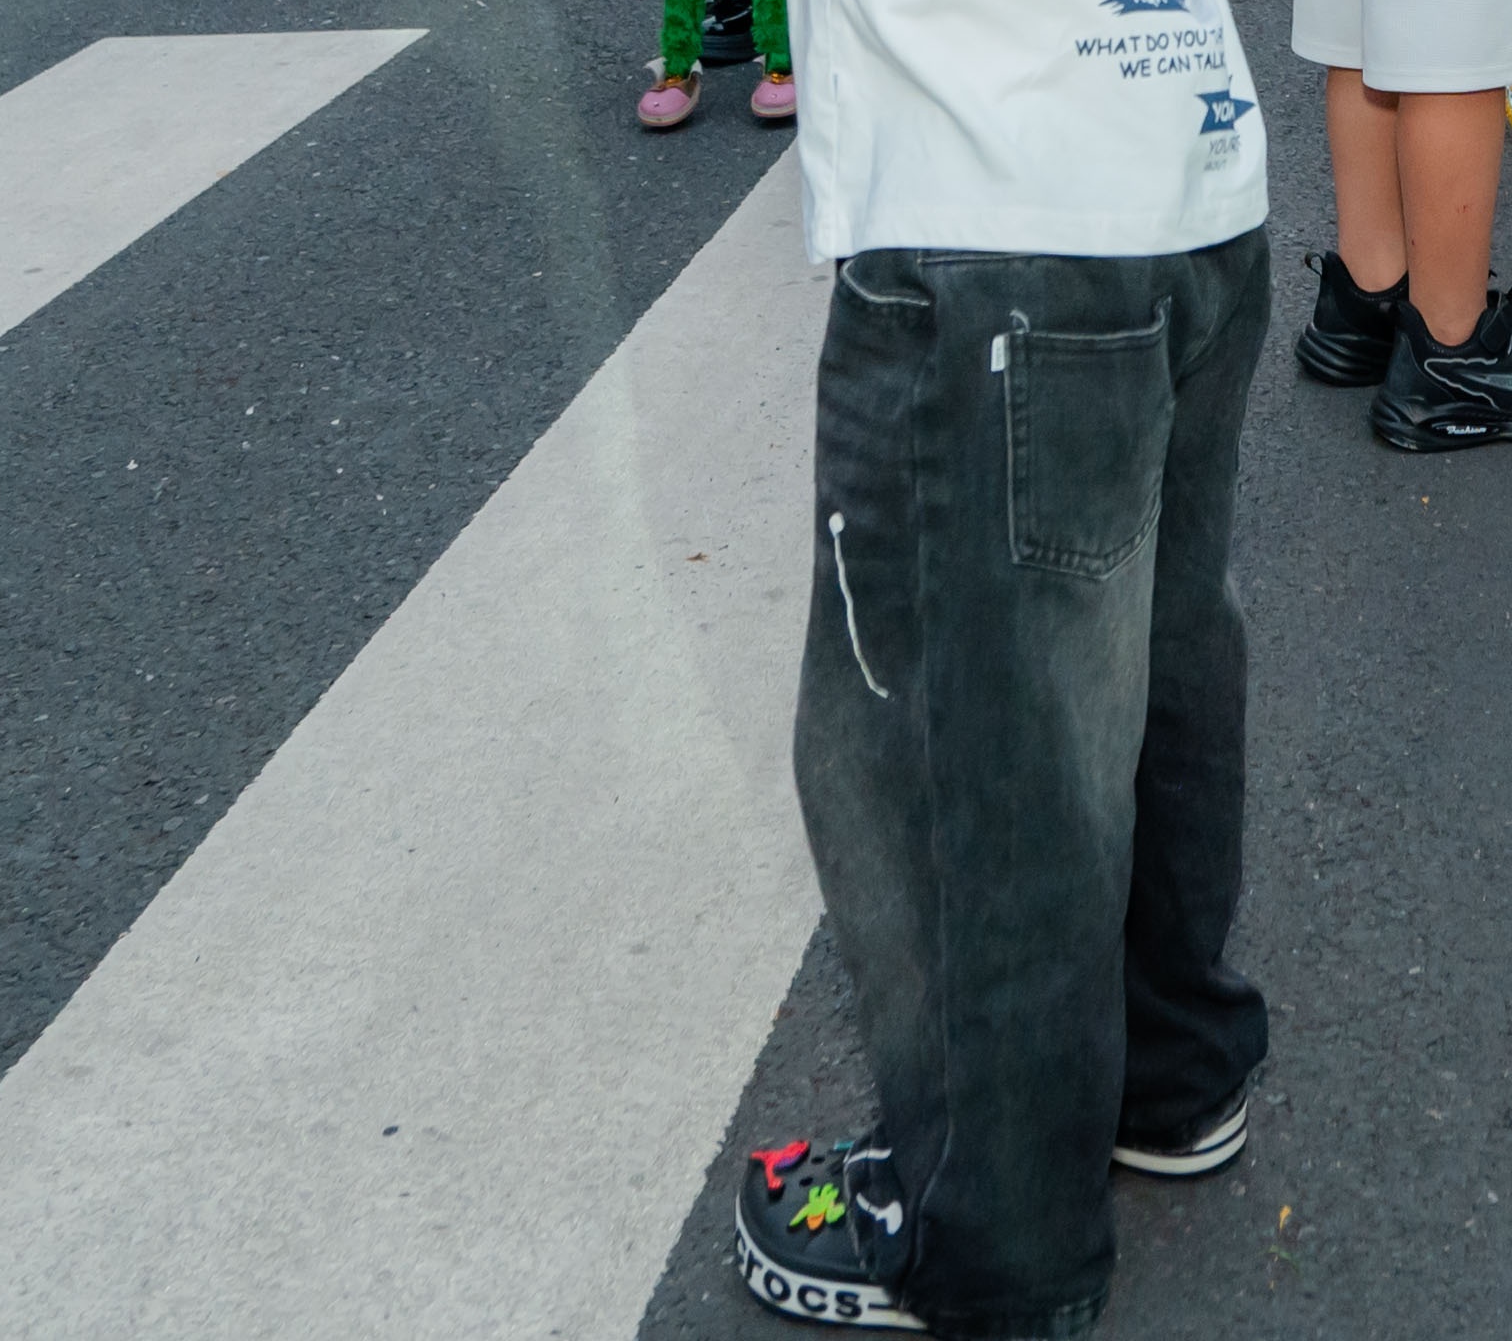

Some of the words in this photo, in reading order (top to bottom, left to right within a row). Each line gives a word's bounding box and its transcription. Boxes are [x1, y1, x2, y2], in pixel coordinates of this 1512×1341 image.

[1075, 35, 1141, 58] WHAT
[1146, 32, 1170, 51] DO
[1174, 29, 1207, 48] YOU
[1120, 59, 1151, 79] WE
[1157, 54, 1190, 75] CAN
